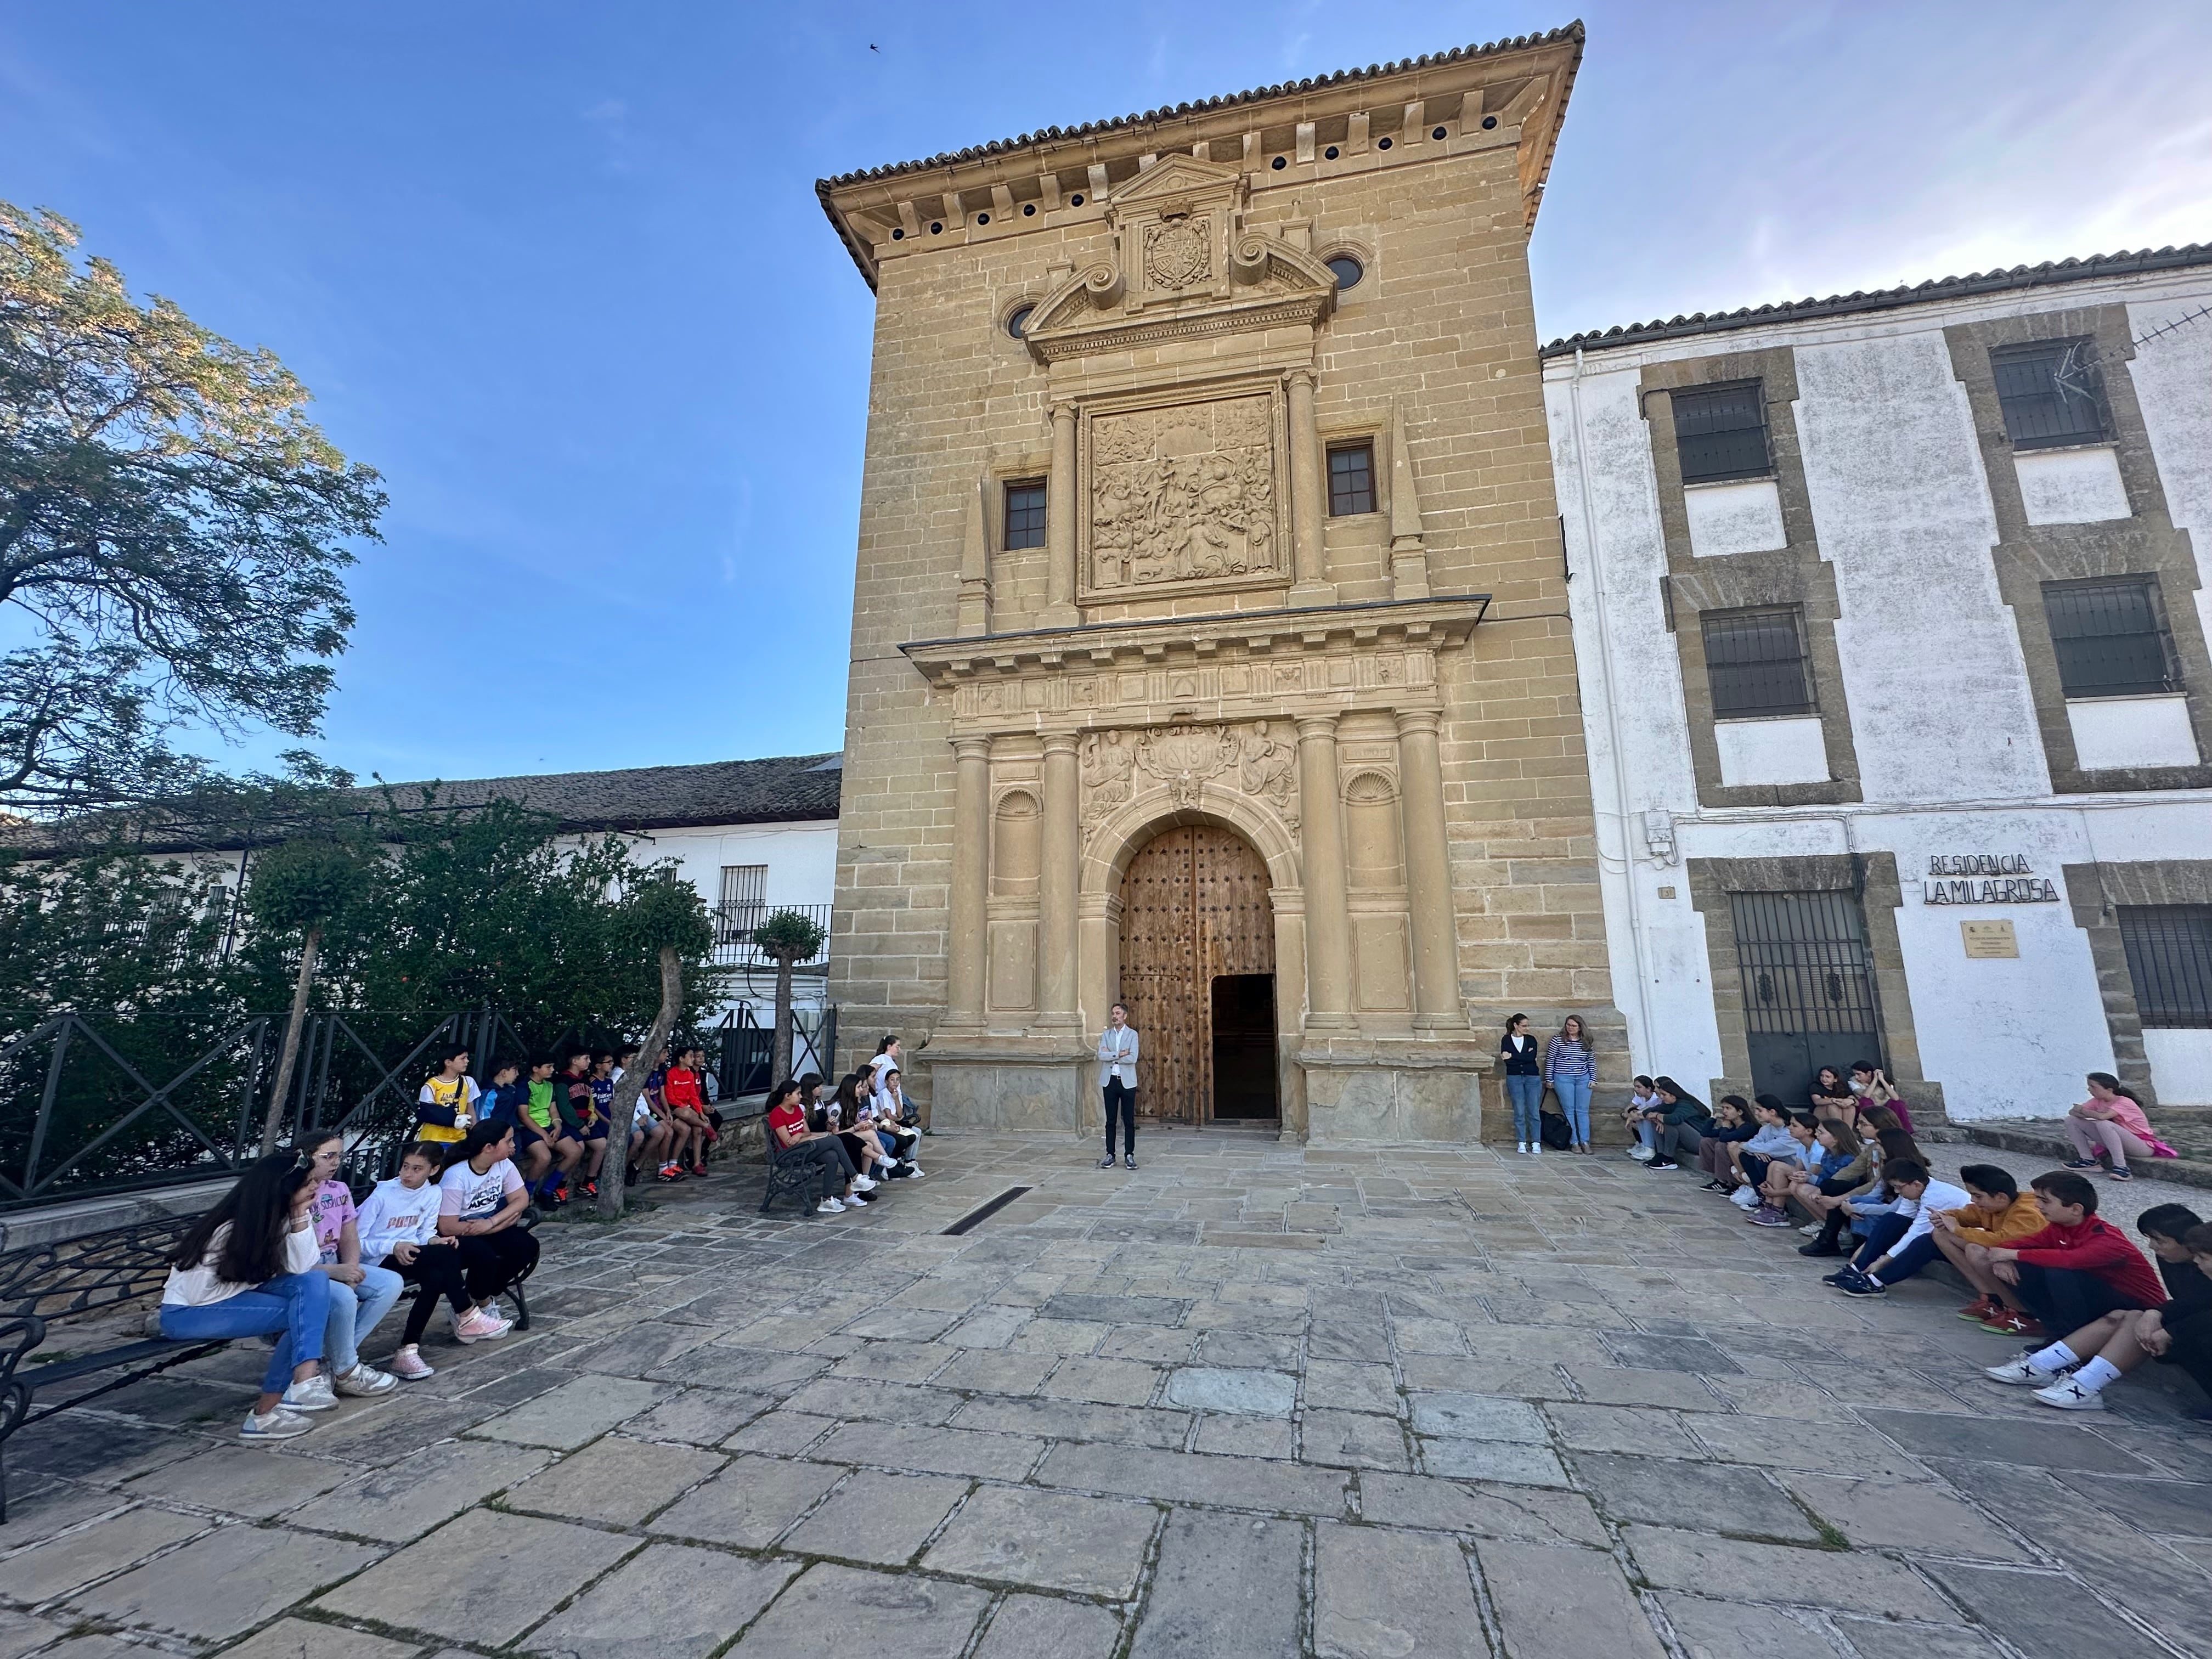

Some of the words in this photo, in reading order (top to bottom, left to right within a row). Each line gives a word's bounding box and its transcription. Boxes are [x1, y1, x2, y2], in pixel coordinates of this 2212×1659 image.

[1931, 854, 2031, 873] RESIDENCIA
[1924, 881, 1949, 902] LA
[1950, 878, 2059, 902] MILAGROSA
[467, 1192, 500, 1210] MICKEY
